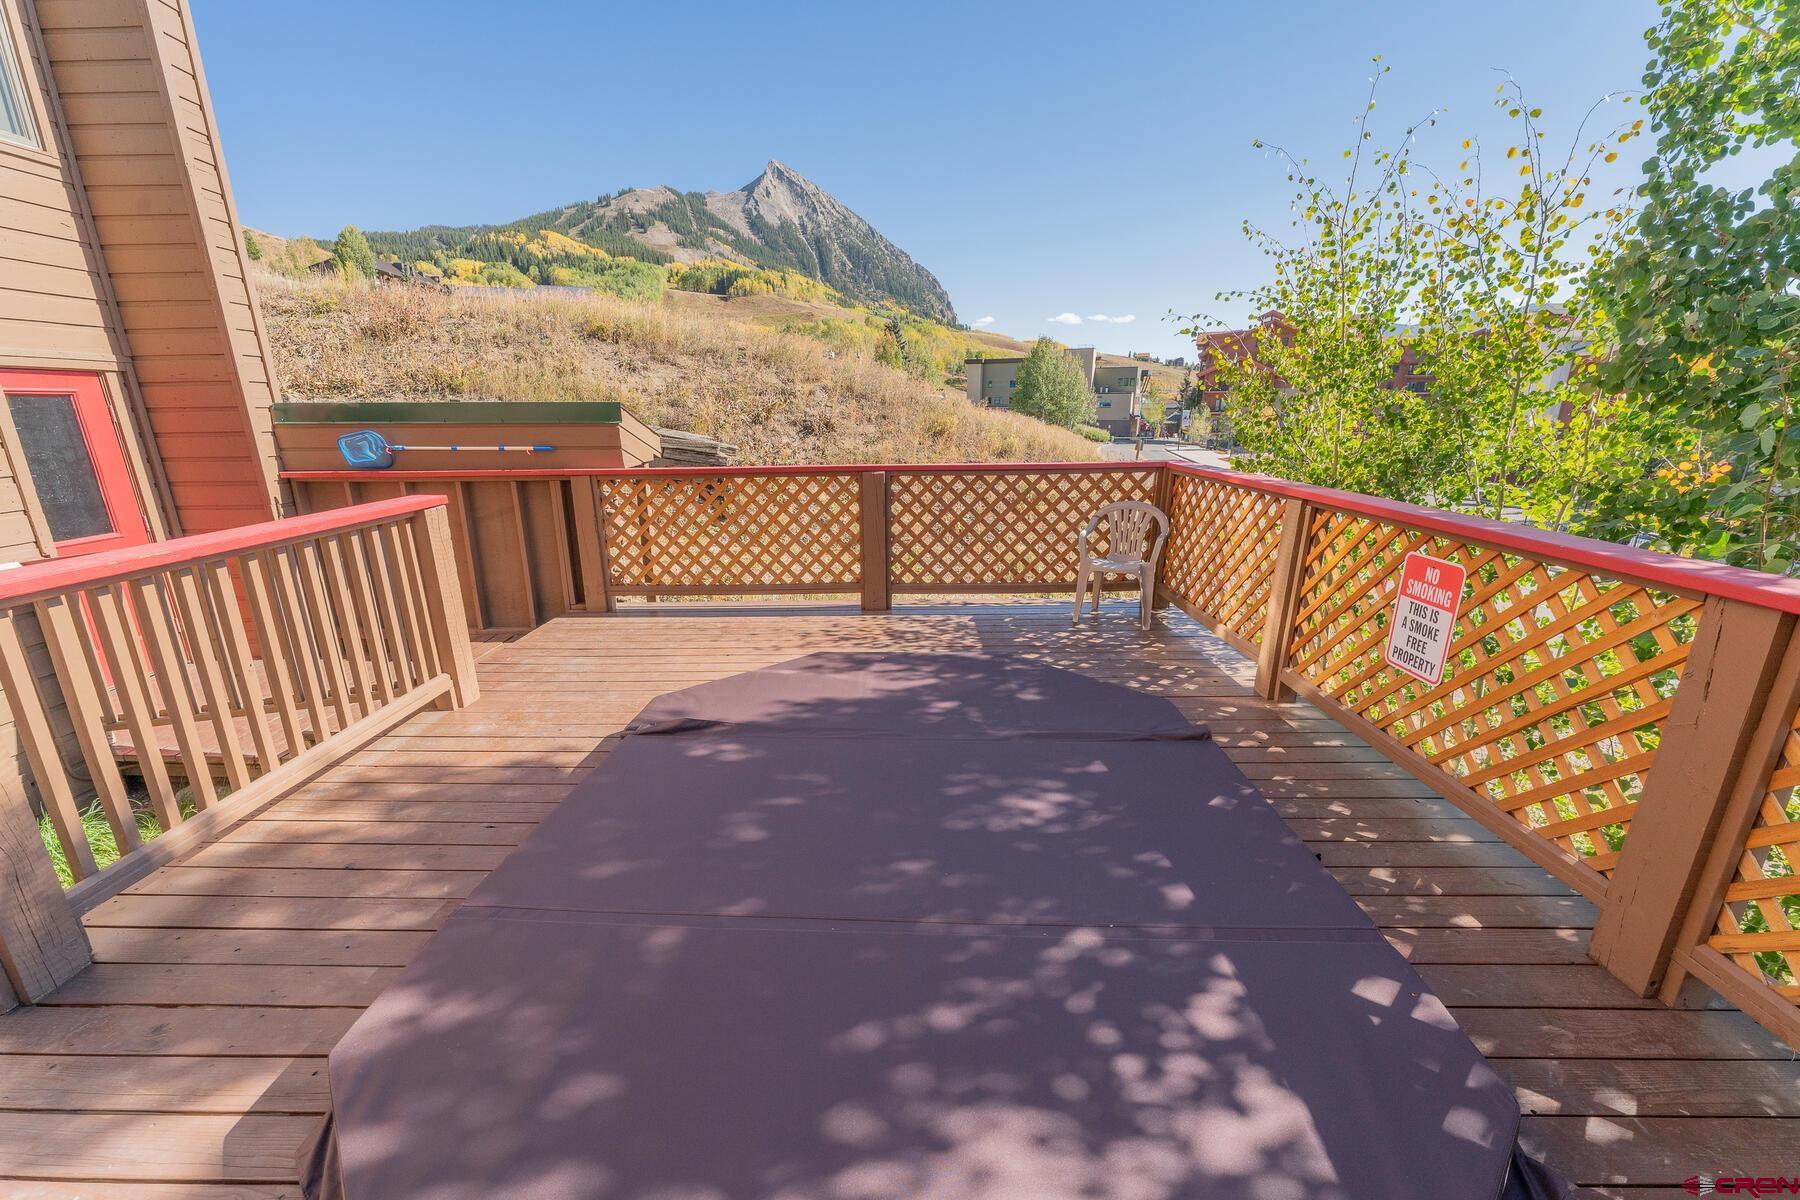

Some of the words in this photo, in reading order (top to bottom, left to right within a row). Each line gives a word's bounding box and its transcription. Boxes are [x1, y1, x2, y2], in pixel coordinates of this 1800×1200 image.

[1425, 567, 1440, 585] NO
[1406, 579, 1453, 608] SMOKING
[1408, 601, 1428, 619] THIS
[1429, 609, 1440, 624] IS
[1401, 616, 1408, 629] A
[1408, 619, 1440, 642] SMOKE
[1406, 635, 1428, 655] FREE
[1391, 645, 1436, 677] PROPERTY
